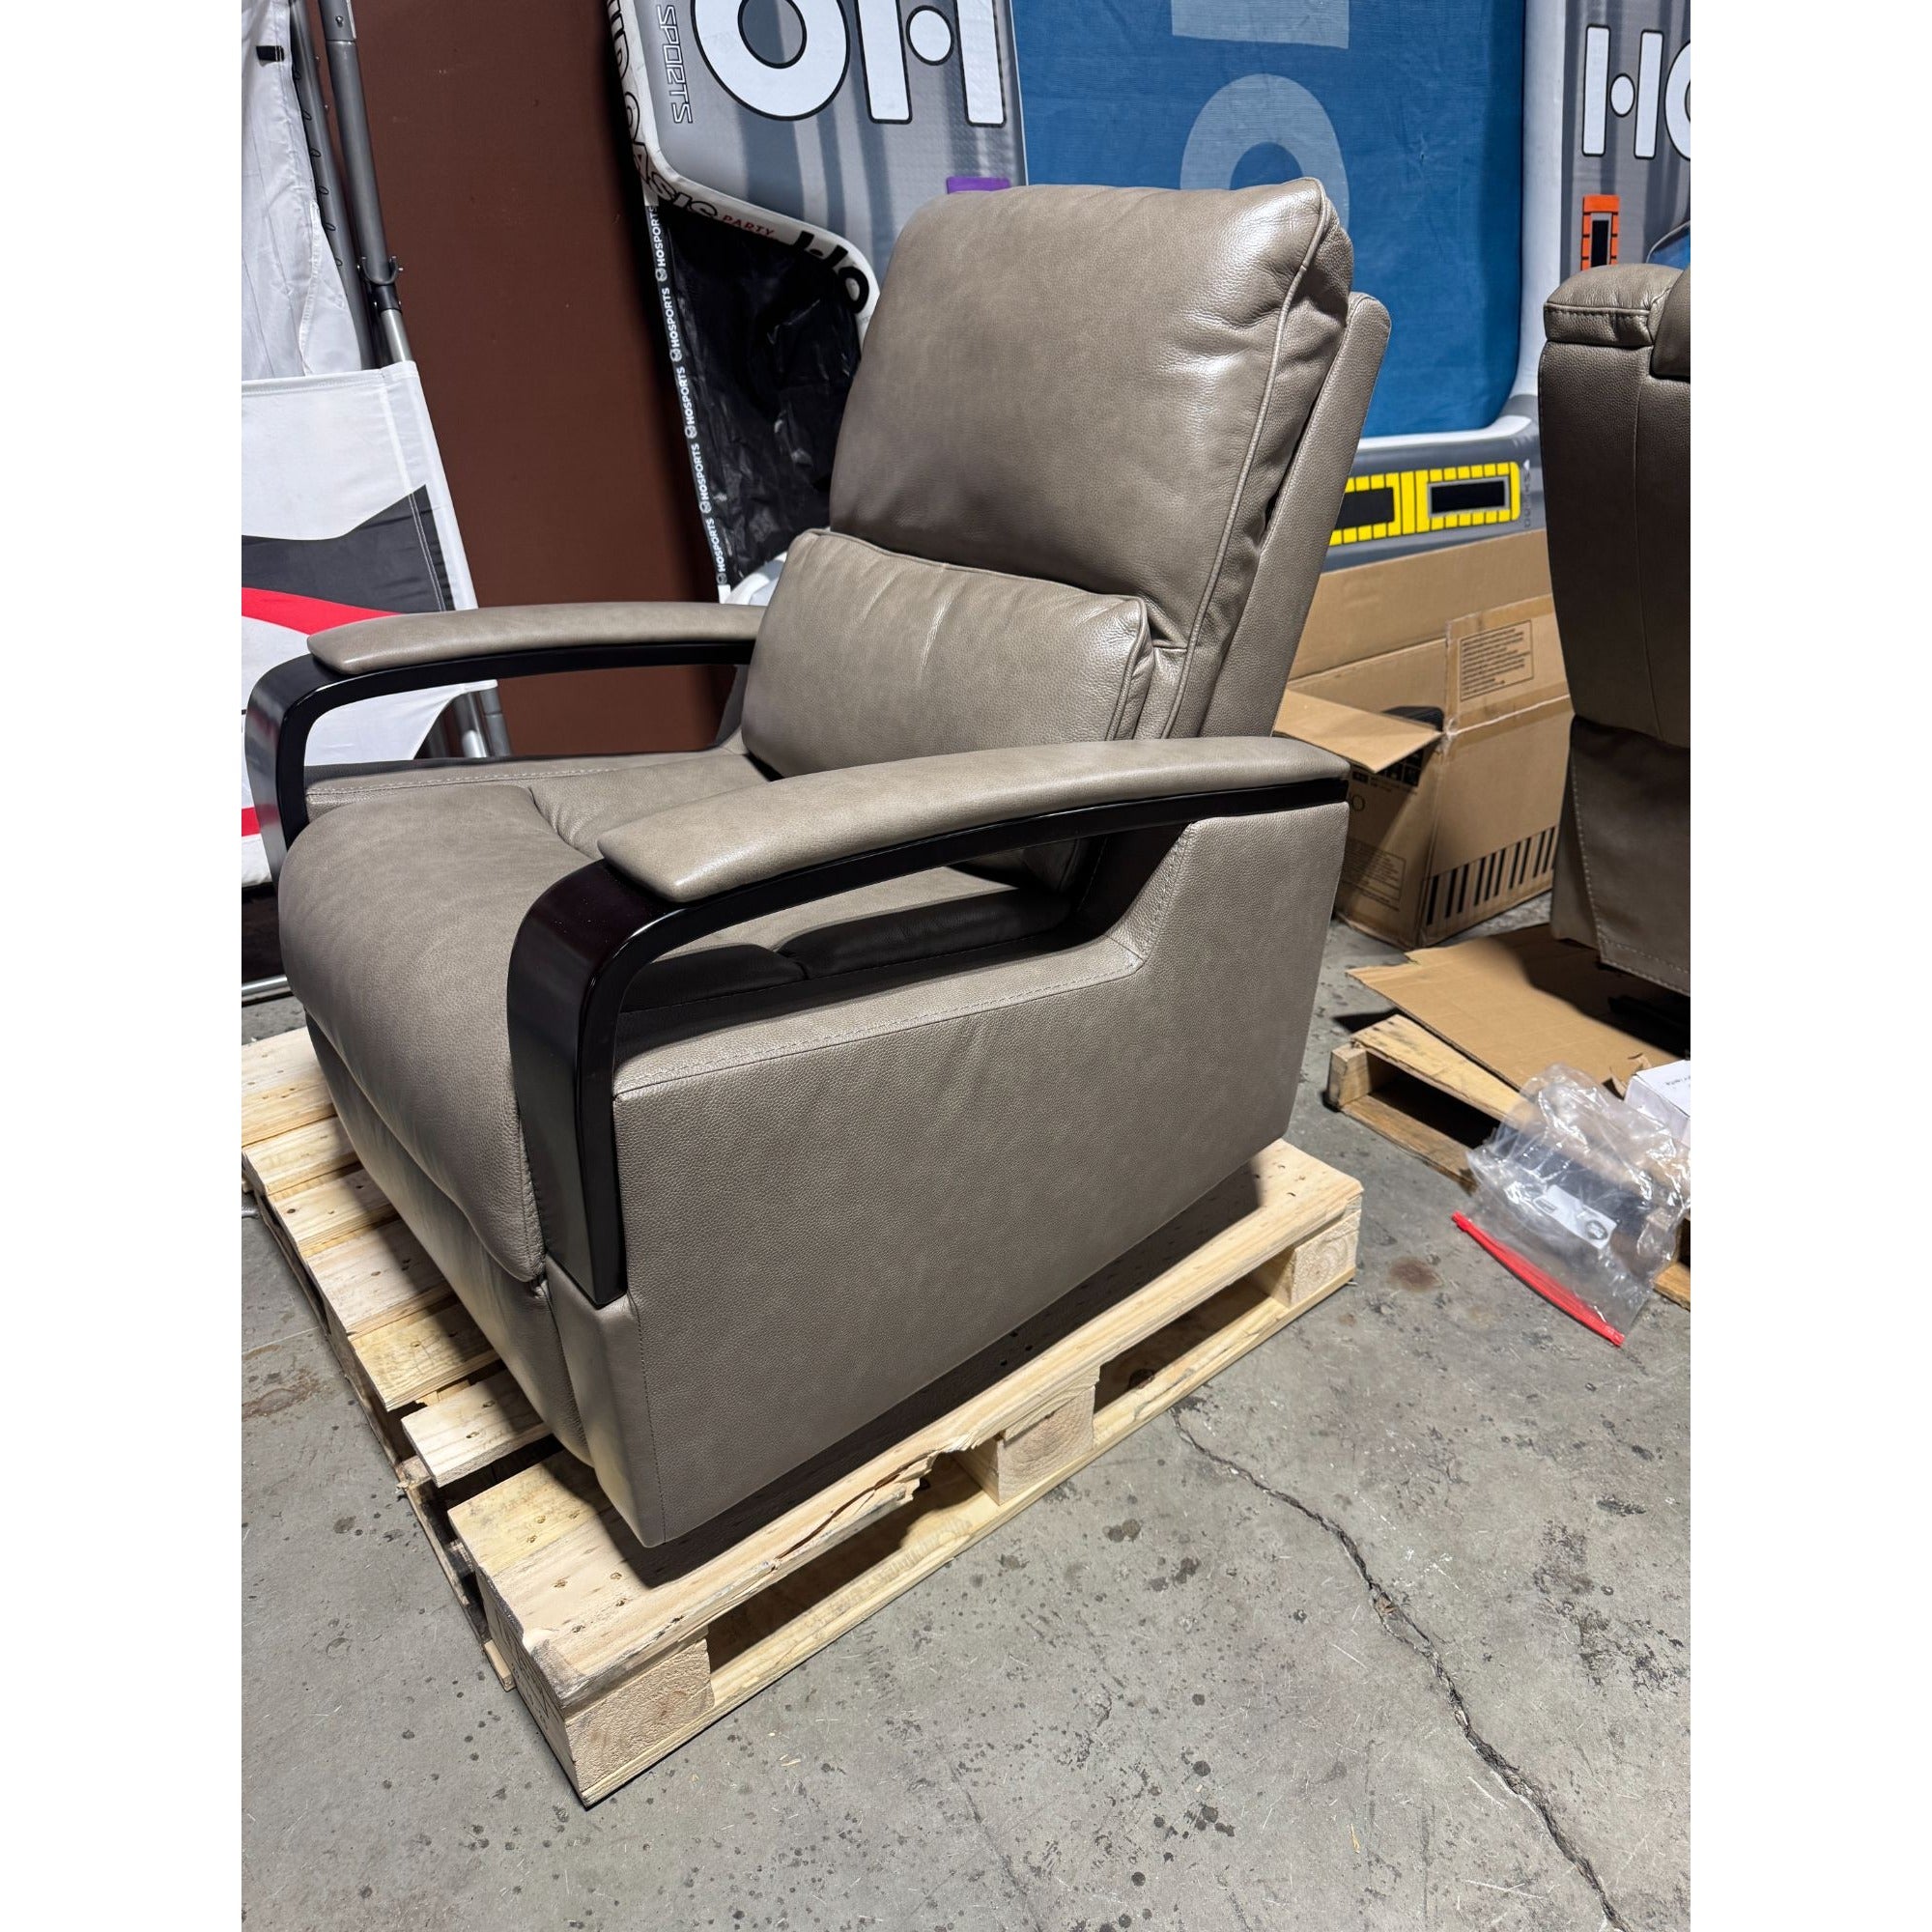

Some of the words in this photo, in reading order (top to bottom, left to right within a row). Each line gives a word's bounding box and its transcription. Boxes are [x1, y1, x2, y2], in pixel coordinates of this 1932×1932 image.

[657, 4, 694, 124] SPORTS
[661, 287, 681, 349] HOSPORTS
[676, 366, 696, 425] HOSPORTS
[691, 442, 710, 501] HOSPORTS
[705, 517, 726, 573] HOSPORTS
